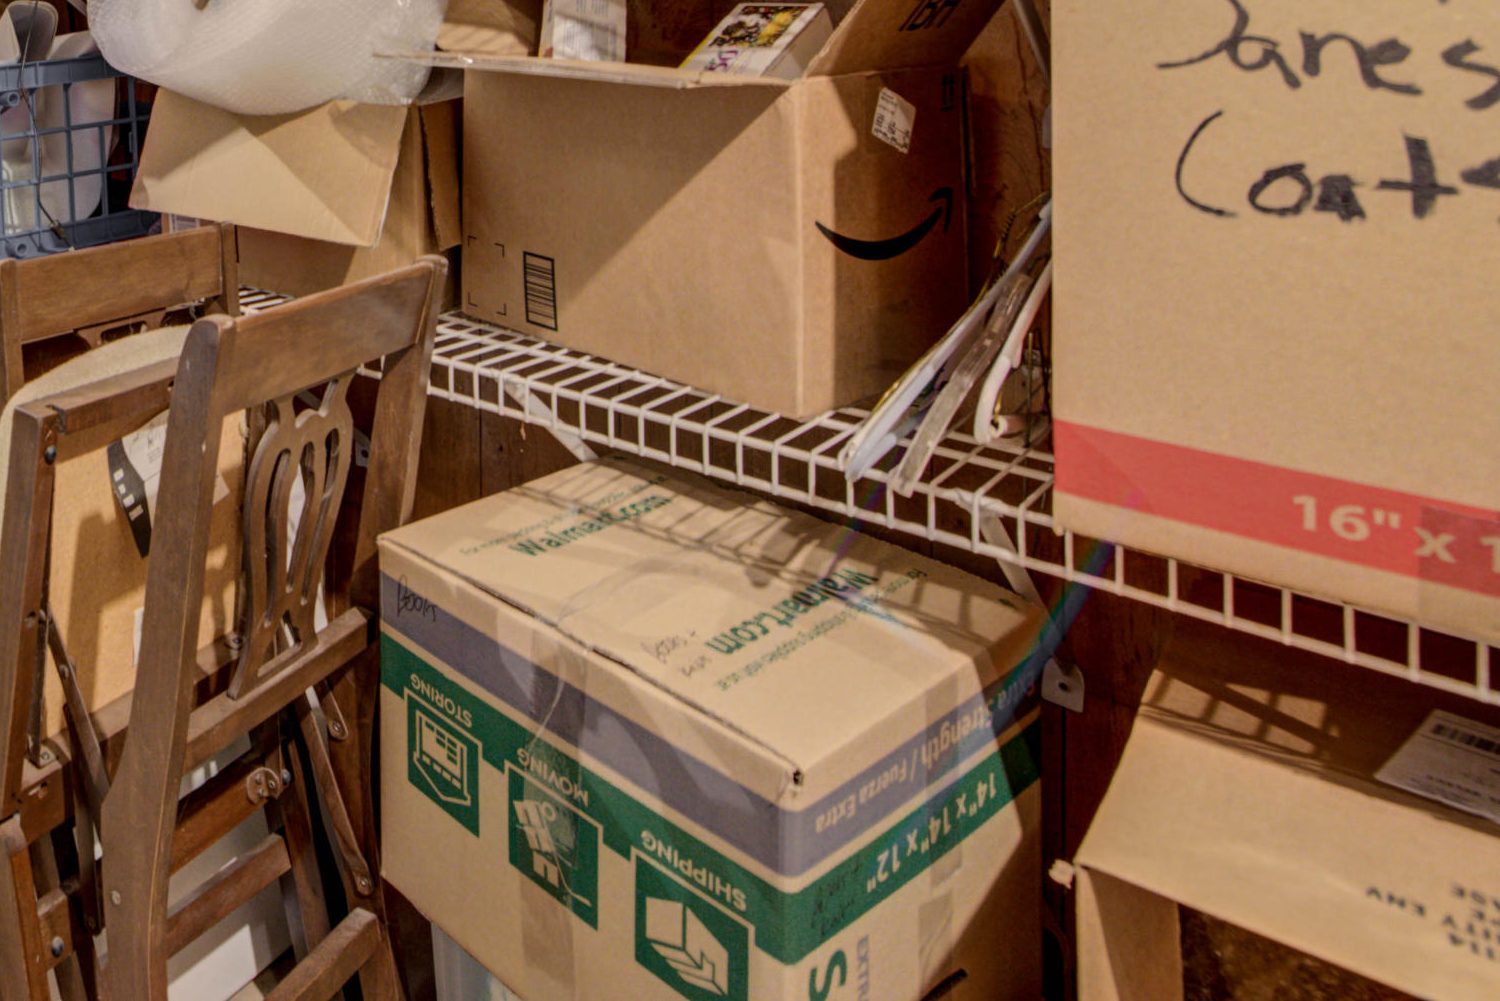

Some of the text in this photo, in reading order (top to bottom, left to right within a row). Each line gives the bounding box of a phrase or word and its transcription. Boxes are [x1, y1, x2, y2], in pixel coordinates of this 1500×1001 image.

[508, 495, 673, 557] Walmart.com
[1293, 496, 1400, 542] 16"
[1412, 527, 1457, 564] x
[704, 569, 879, 655] Walmart.com
[410, 672, 473, 729] STORING
[921, 702, 993, 771] Strength
[517, 747, 589, 808] MOVING
[859, 761, 908, 804] Fuerza
[815, 805, 858, 834] Extra
[867, 772, 997, 893] 14" x 14" x 12"
[641, 829, 748, 912] SHIPPING
